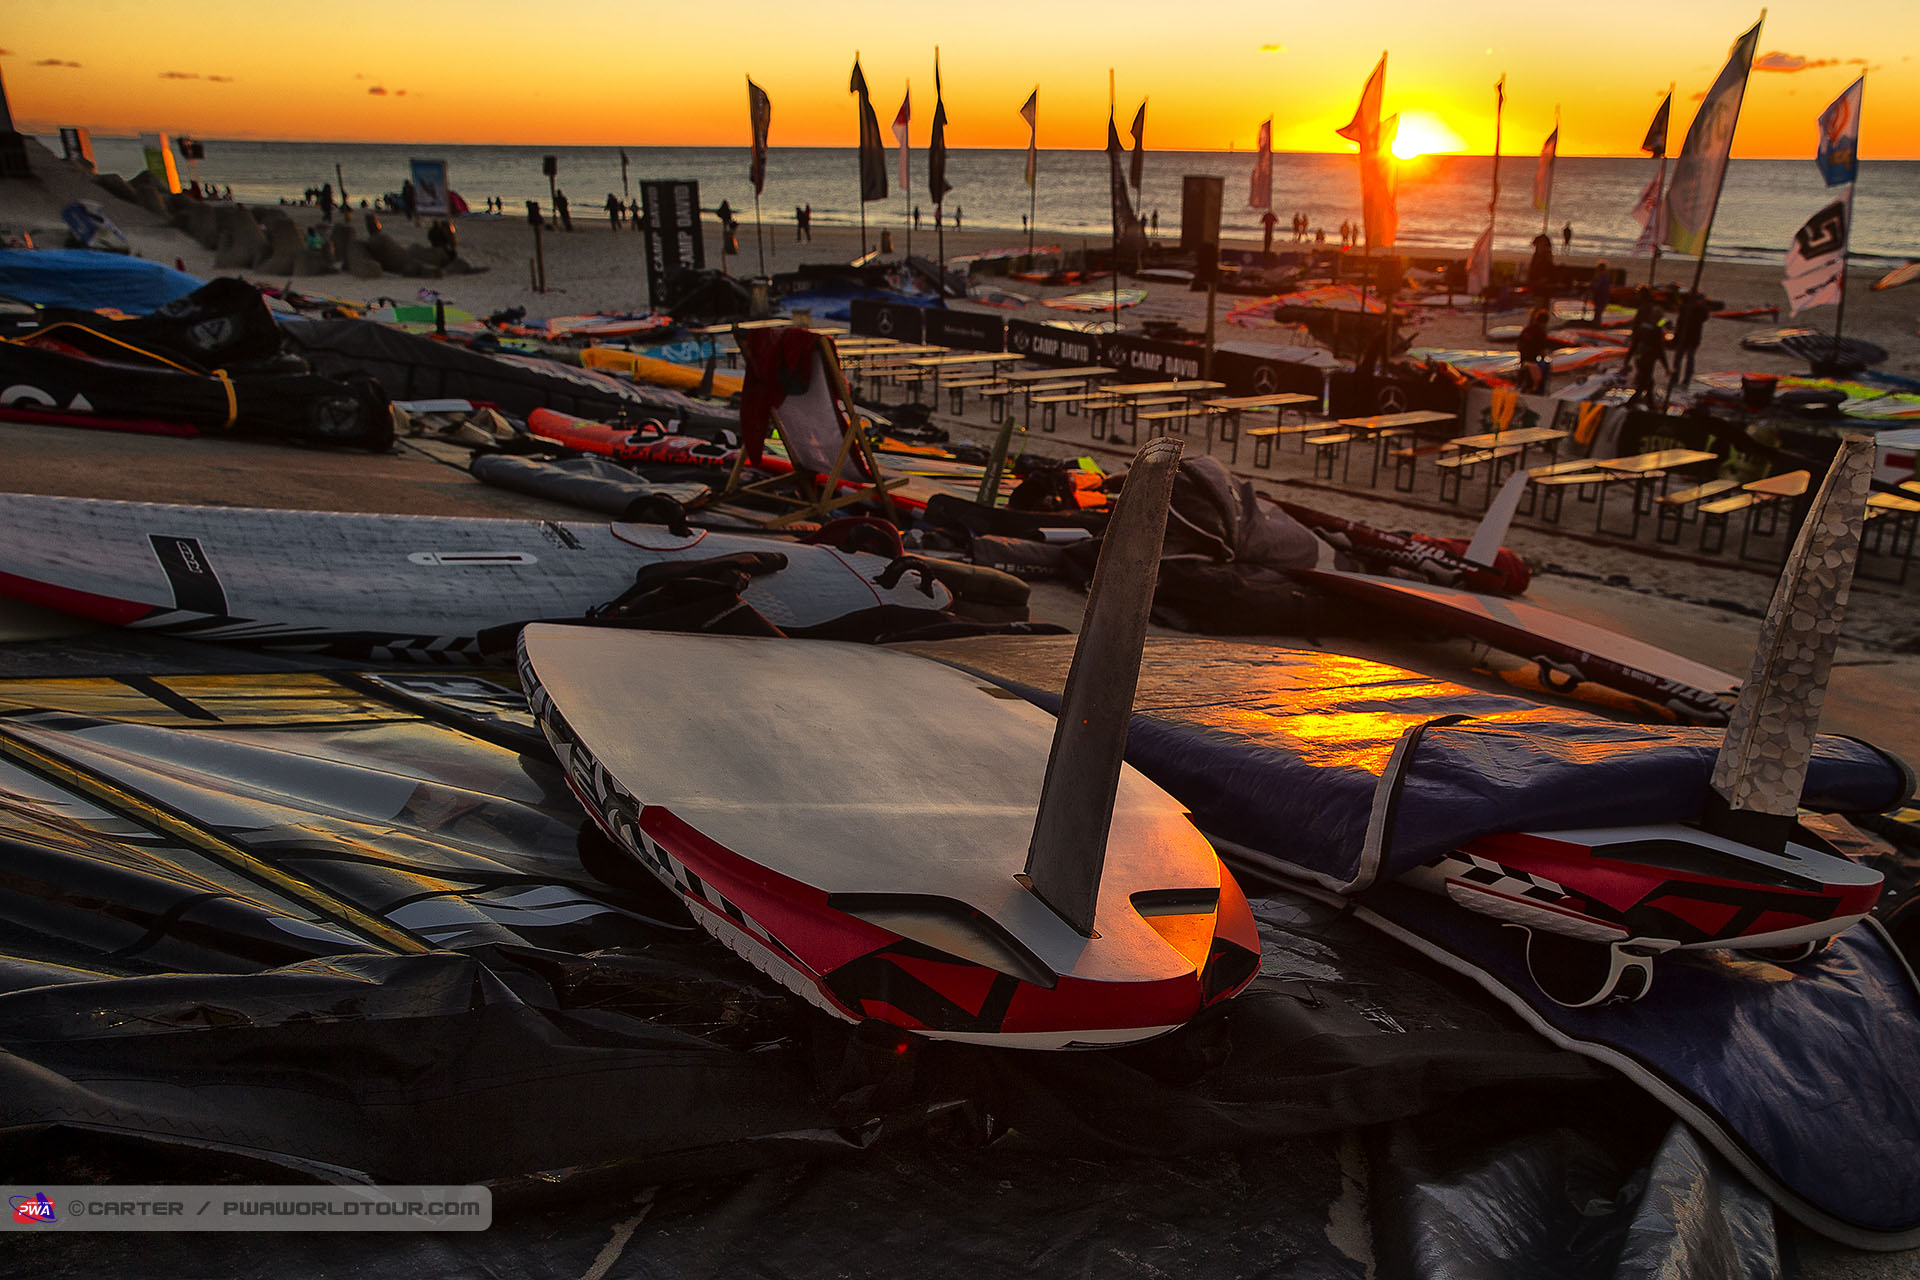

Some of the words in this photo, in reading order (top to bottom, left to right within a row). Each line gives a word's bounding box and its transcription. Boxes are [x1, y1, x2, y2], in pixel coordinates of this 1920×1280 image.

[1032, 336, 1059, 354] CAMP
[1061, 342, 1089, 362] DAVID
[1131, 350, 1163, 372] CAMP
[1165, 356, 1198, 378] DAVID
